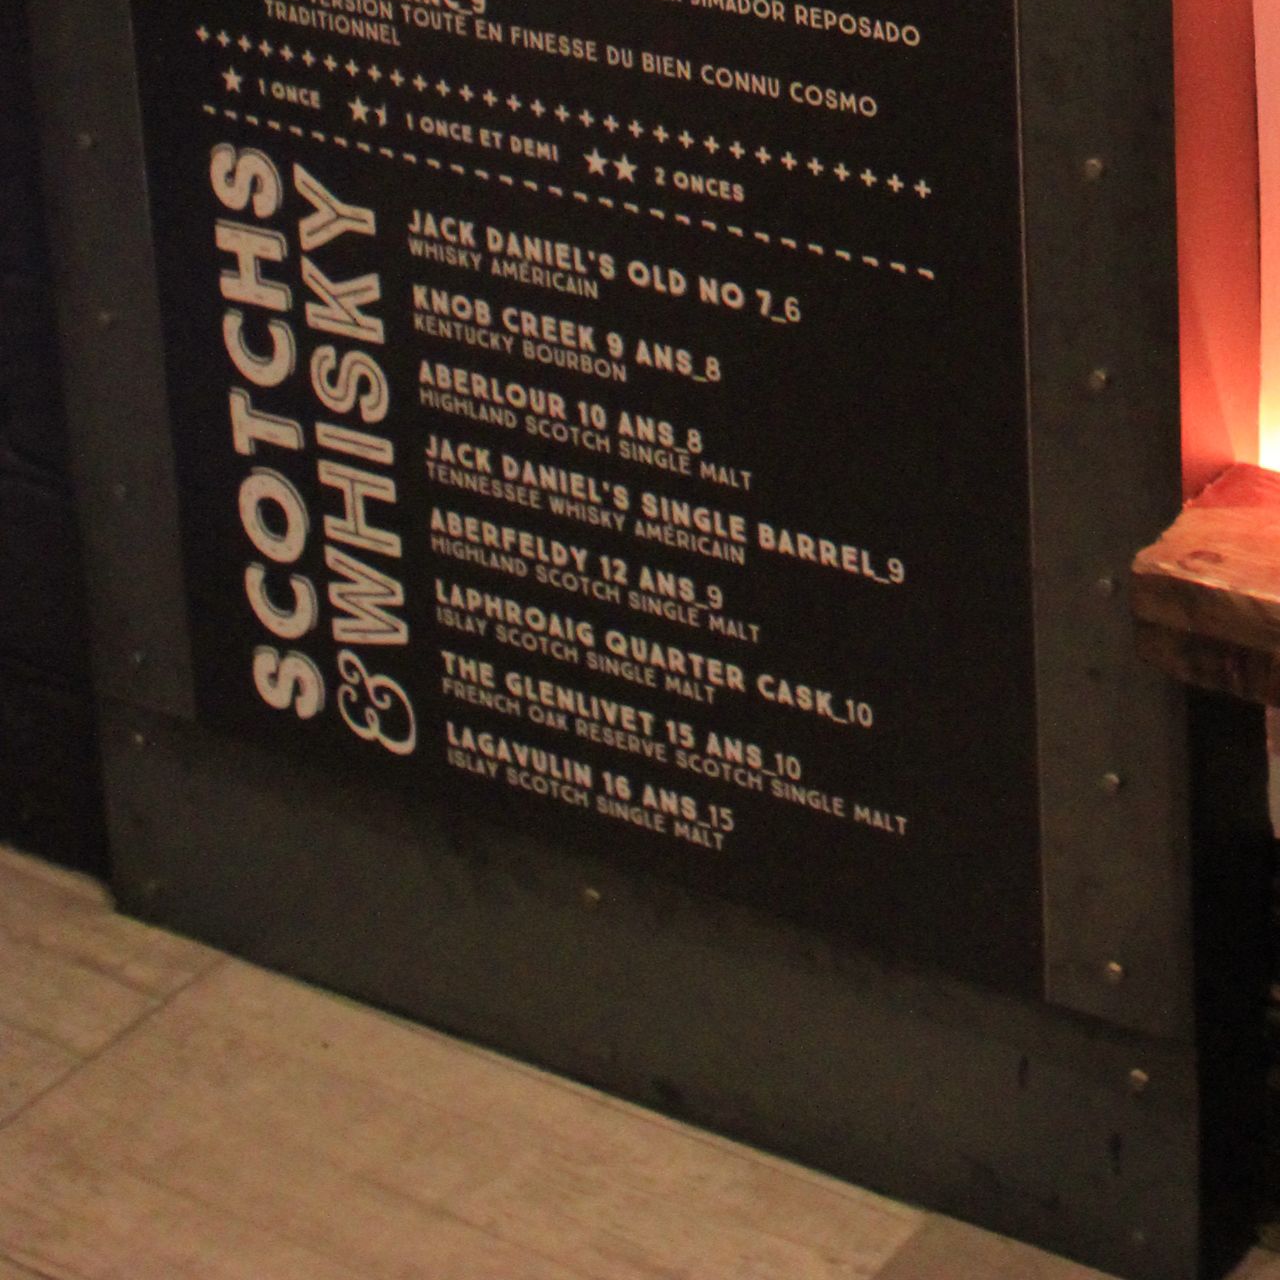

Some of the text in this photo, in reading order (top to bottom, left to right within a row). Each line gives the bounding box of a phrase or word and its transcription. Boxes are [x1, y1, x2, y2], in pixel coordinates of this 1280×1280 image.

[642, 52, 877, 118] BIEN CONNU COSMO
[510, 135, 558, 163] DEMI
[408, 210, 687, 297] JACK DANIEL'S OLD
[412, 283, 596, 353] KNOB CREEK
[419, 359, 606, 431] ABERLOUR 10
[522, 341, 627, 383] BOURBON
[210, 142, 326, 721] SCOTCHS
[293, 162, 409, 645] WHISKY
[430, 507, 627, 585] ABERFELDY 12
[642, 492, 746, 543] SINGLE
[435, 578, 745, 692] LAPHROAIG QUARTER
[441, 649, 656, 736] THE GLENLIVET
[446, 721, 593, 788] LAGAVULIN
[854, 804, 907, 835] MALT
